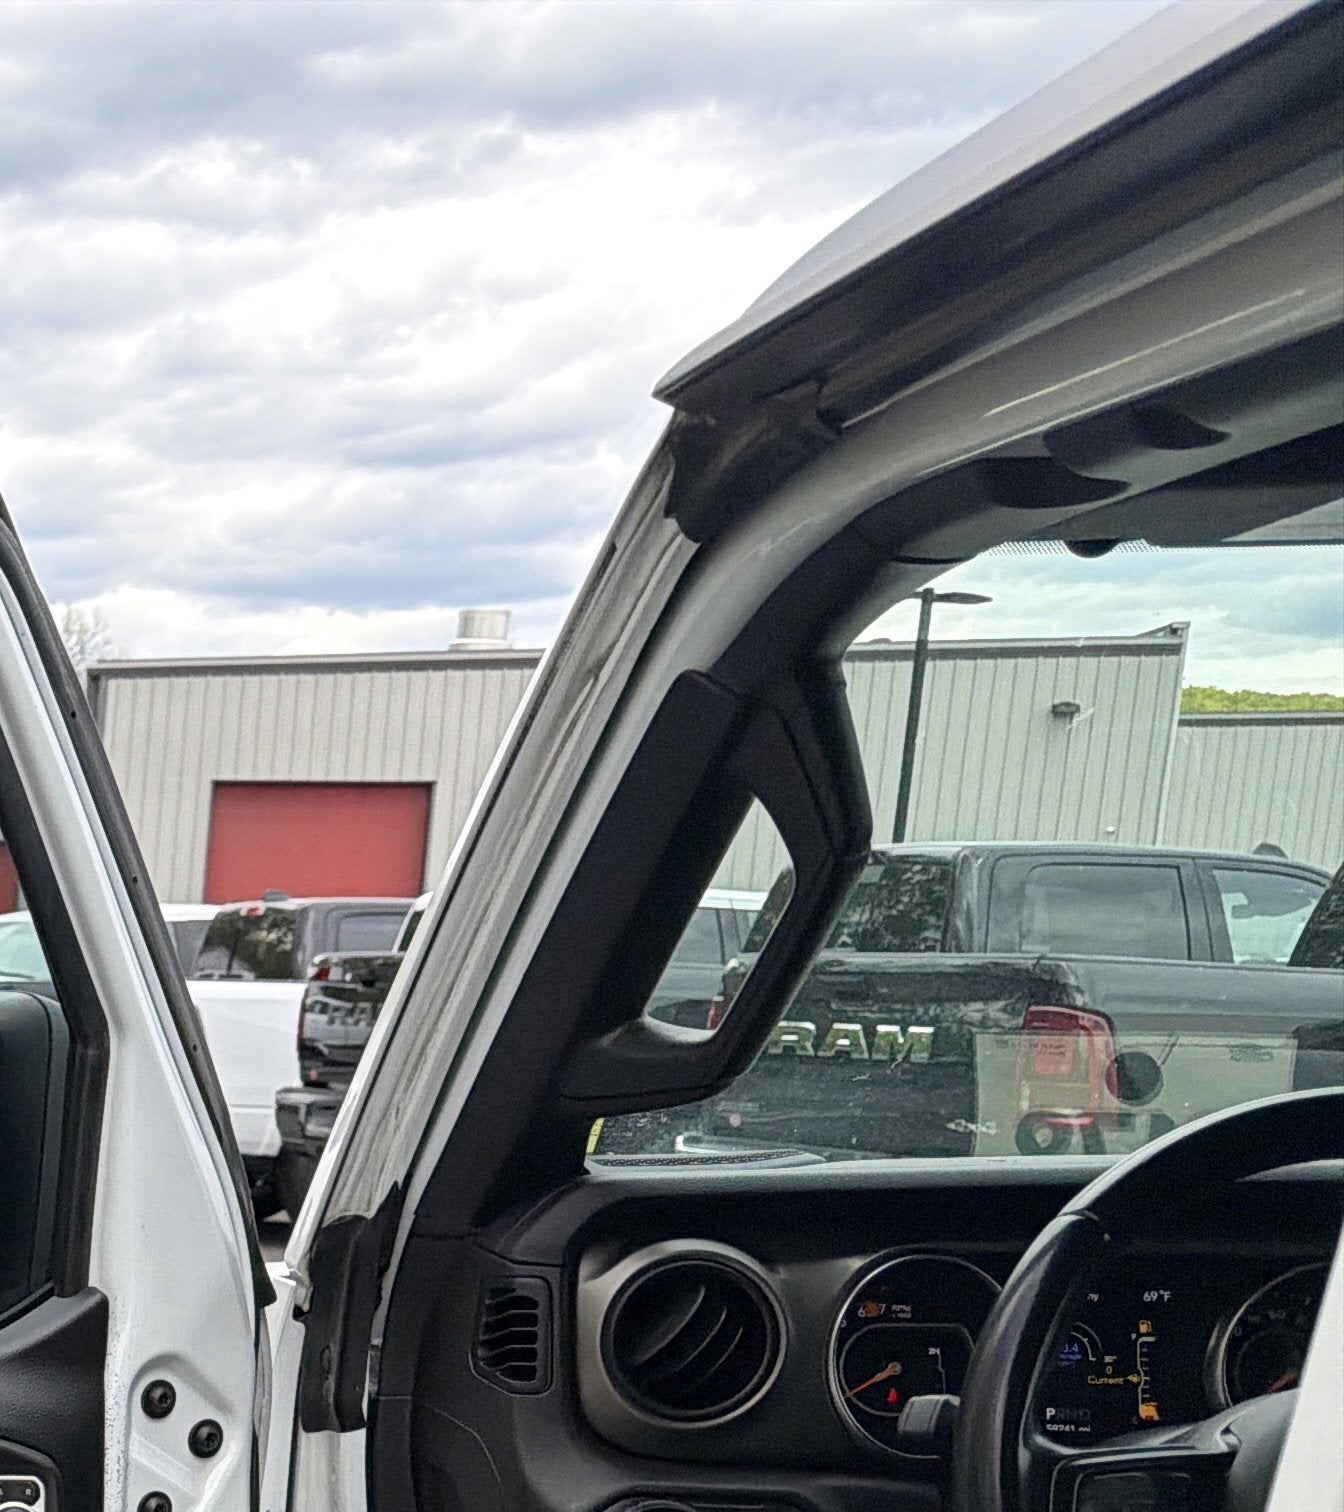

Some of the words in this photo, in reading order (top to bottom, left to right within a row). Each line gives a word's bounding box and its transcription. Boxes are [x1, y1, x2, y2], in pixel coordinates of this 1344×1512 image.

[767, 1020, 935, 1063] RAM
[1143, 1289, 1171, 1302] 69°F
[25, 1488, 32, 1496] R
